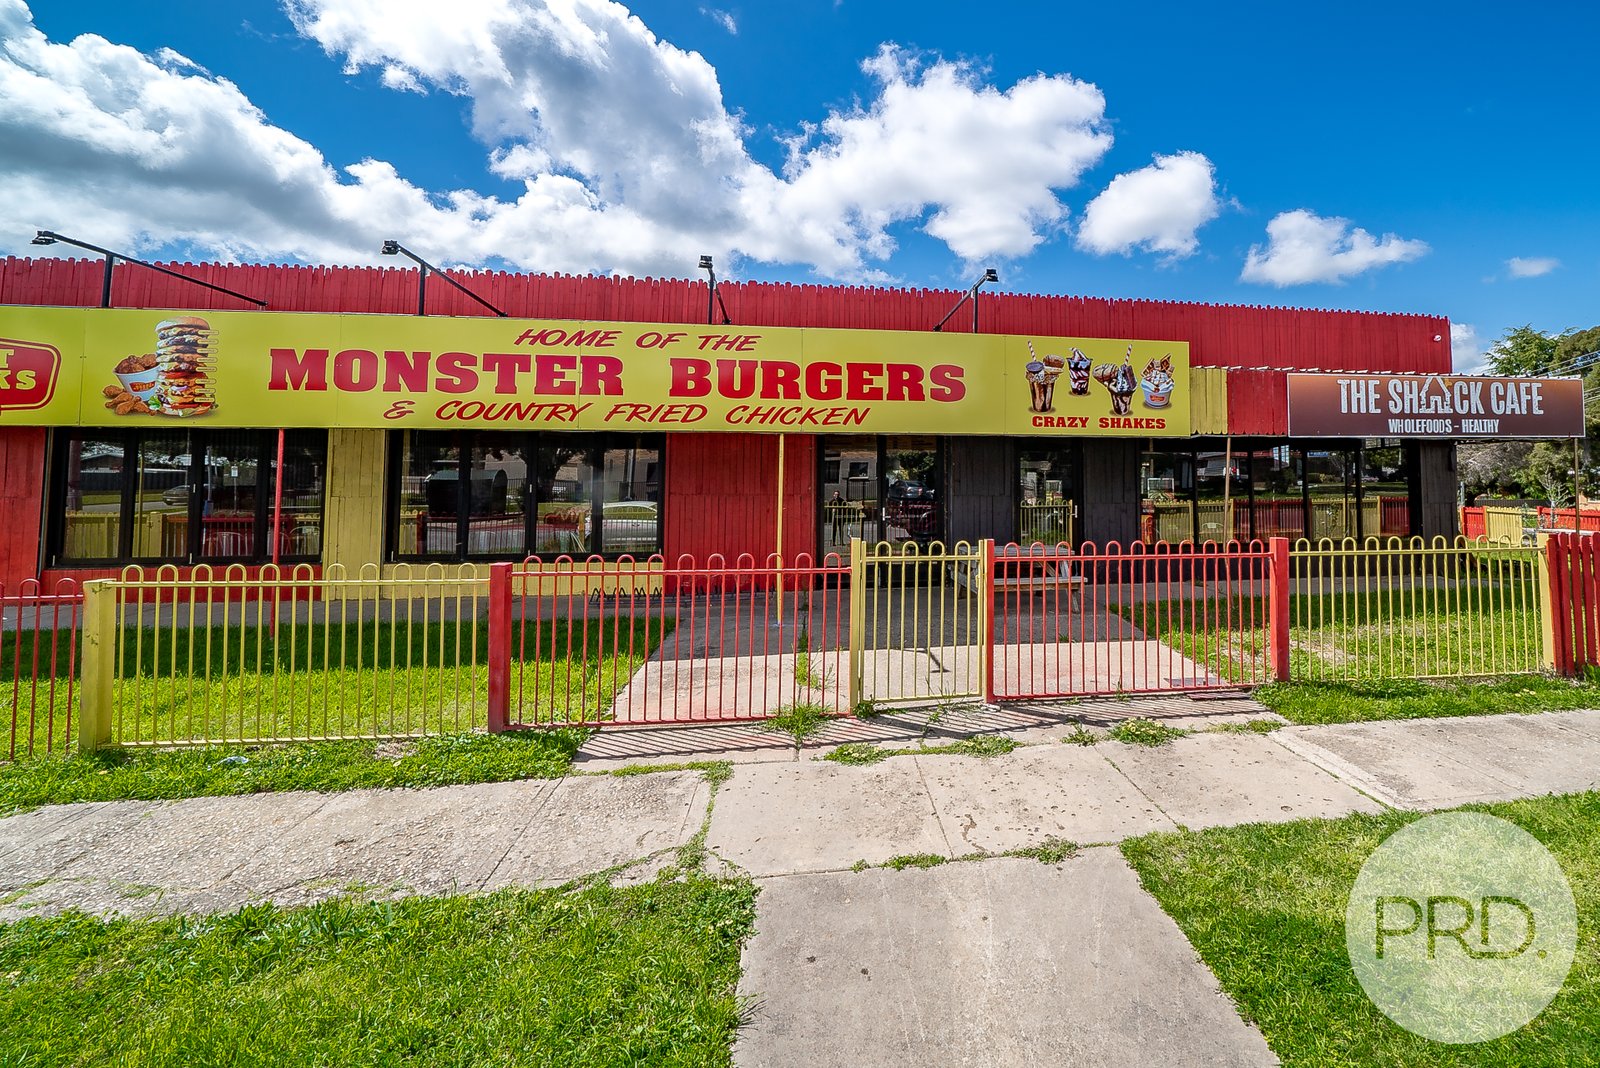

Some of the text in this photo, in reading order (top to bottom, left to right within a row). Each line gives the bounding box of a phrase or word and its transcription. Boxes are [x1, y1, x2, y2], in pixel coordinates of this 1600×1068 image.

[514, 328, 762, 351] HOME OF THE
[268, 348, 966, 402] MONSTER BURGERS
[1337, 379, 1382, 414] THE
[1490, 381, 1544, 415] CAFE
[383, 400, 871, 426] & COUNTRY FRIED CHICKEN
[1032, 416, 1166, 430] CRAZY SHAKES
[1387, 418, 1453, 434] WHOLEFOODS
[1461, 418, 1500, 434] HEALTHY
